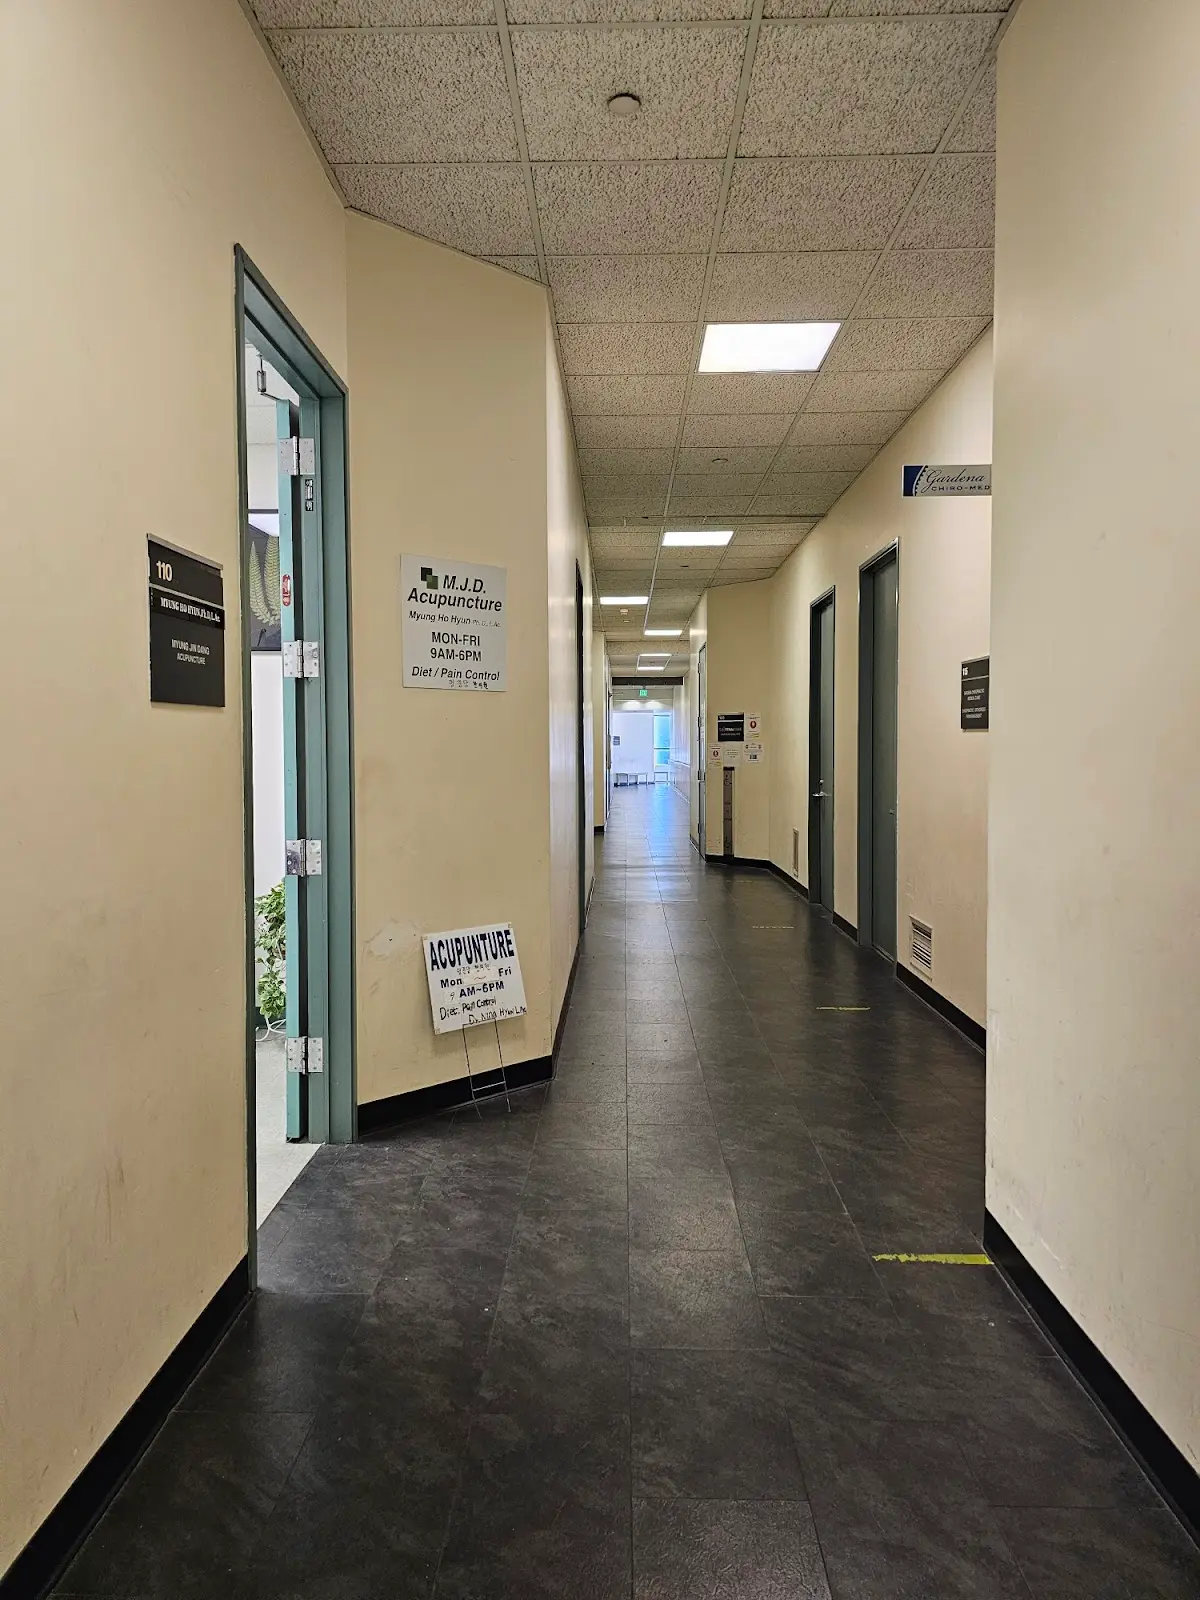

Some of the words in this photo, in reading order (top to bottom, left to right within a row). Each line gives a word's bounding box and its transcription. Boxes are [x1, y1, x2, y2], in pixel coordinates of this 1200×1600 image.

[921, 468, 985, 494] Gardena
[156, 560, 173, 582] 110
[443, 574, 487, 594] M.J.D.
[160, 597, 179, 611] MYUNG
[179, 602, 187, 613] HO
[407, 587, 503, 612] Acupuncture
[409, 610, 436, 623] Myung
[437, 614, 449, 623] Ho
[450, 615, 471, 626] Hyun
[171, 638, 189, 651] MYUNG
[431, 631, 481, 647] MON-FRI
[176, 652, 206, 665] ACUPUNCTURE
[430, 647, 482, 662] 9AM-6PM
[411, 666, 433, 677] Diet
[440, 667, 462, 679] Pain
[465, 669, 500, 681] Control
[429, 929, 515, 972] ACUPUNTURE
[440, 977, 463, 989] Mon
[498, 966, 512, 977] Fri
[459, 980, 505, 999] AM~6PM
